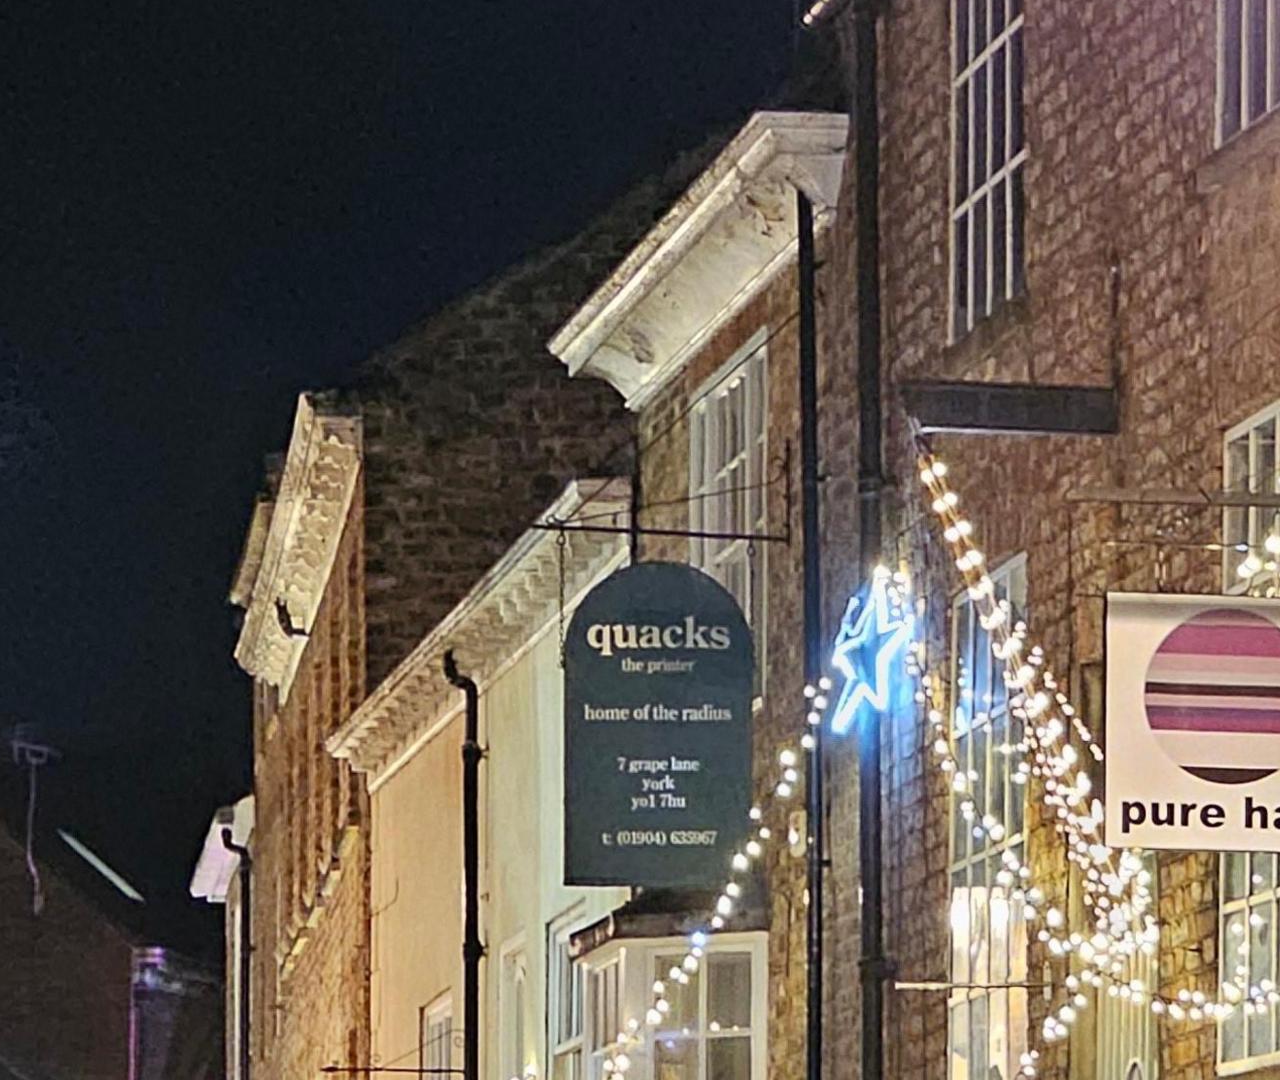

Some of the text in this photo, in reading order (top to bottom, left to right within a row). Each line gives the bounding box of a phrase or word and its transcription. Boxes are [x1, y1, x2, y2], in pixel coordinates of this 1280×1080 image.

[587, 616, 730, 656] quacks
[621, 657, 696, 674] the printer
[584, 704, 732, 721] home of the radius
[617, 756, 700, 773] 7 grape lane
[642, 775, 675, 791] york
[659, 794, 686, 808] 7hu
[1121, 800, 1226, 834] pure
[617, 830, 667, 846] (01904)
